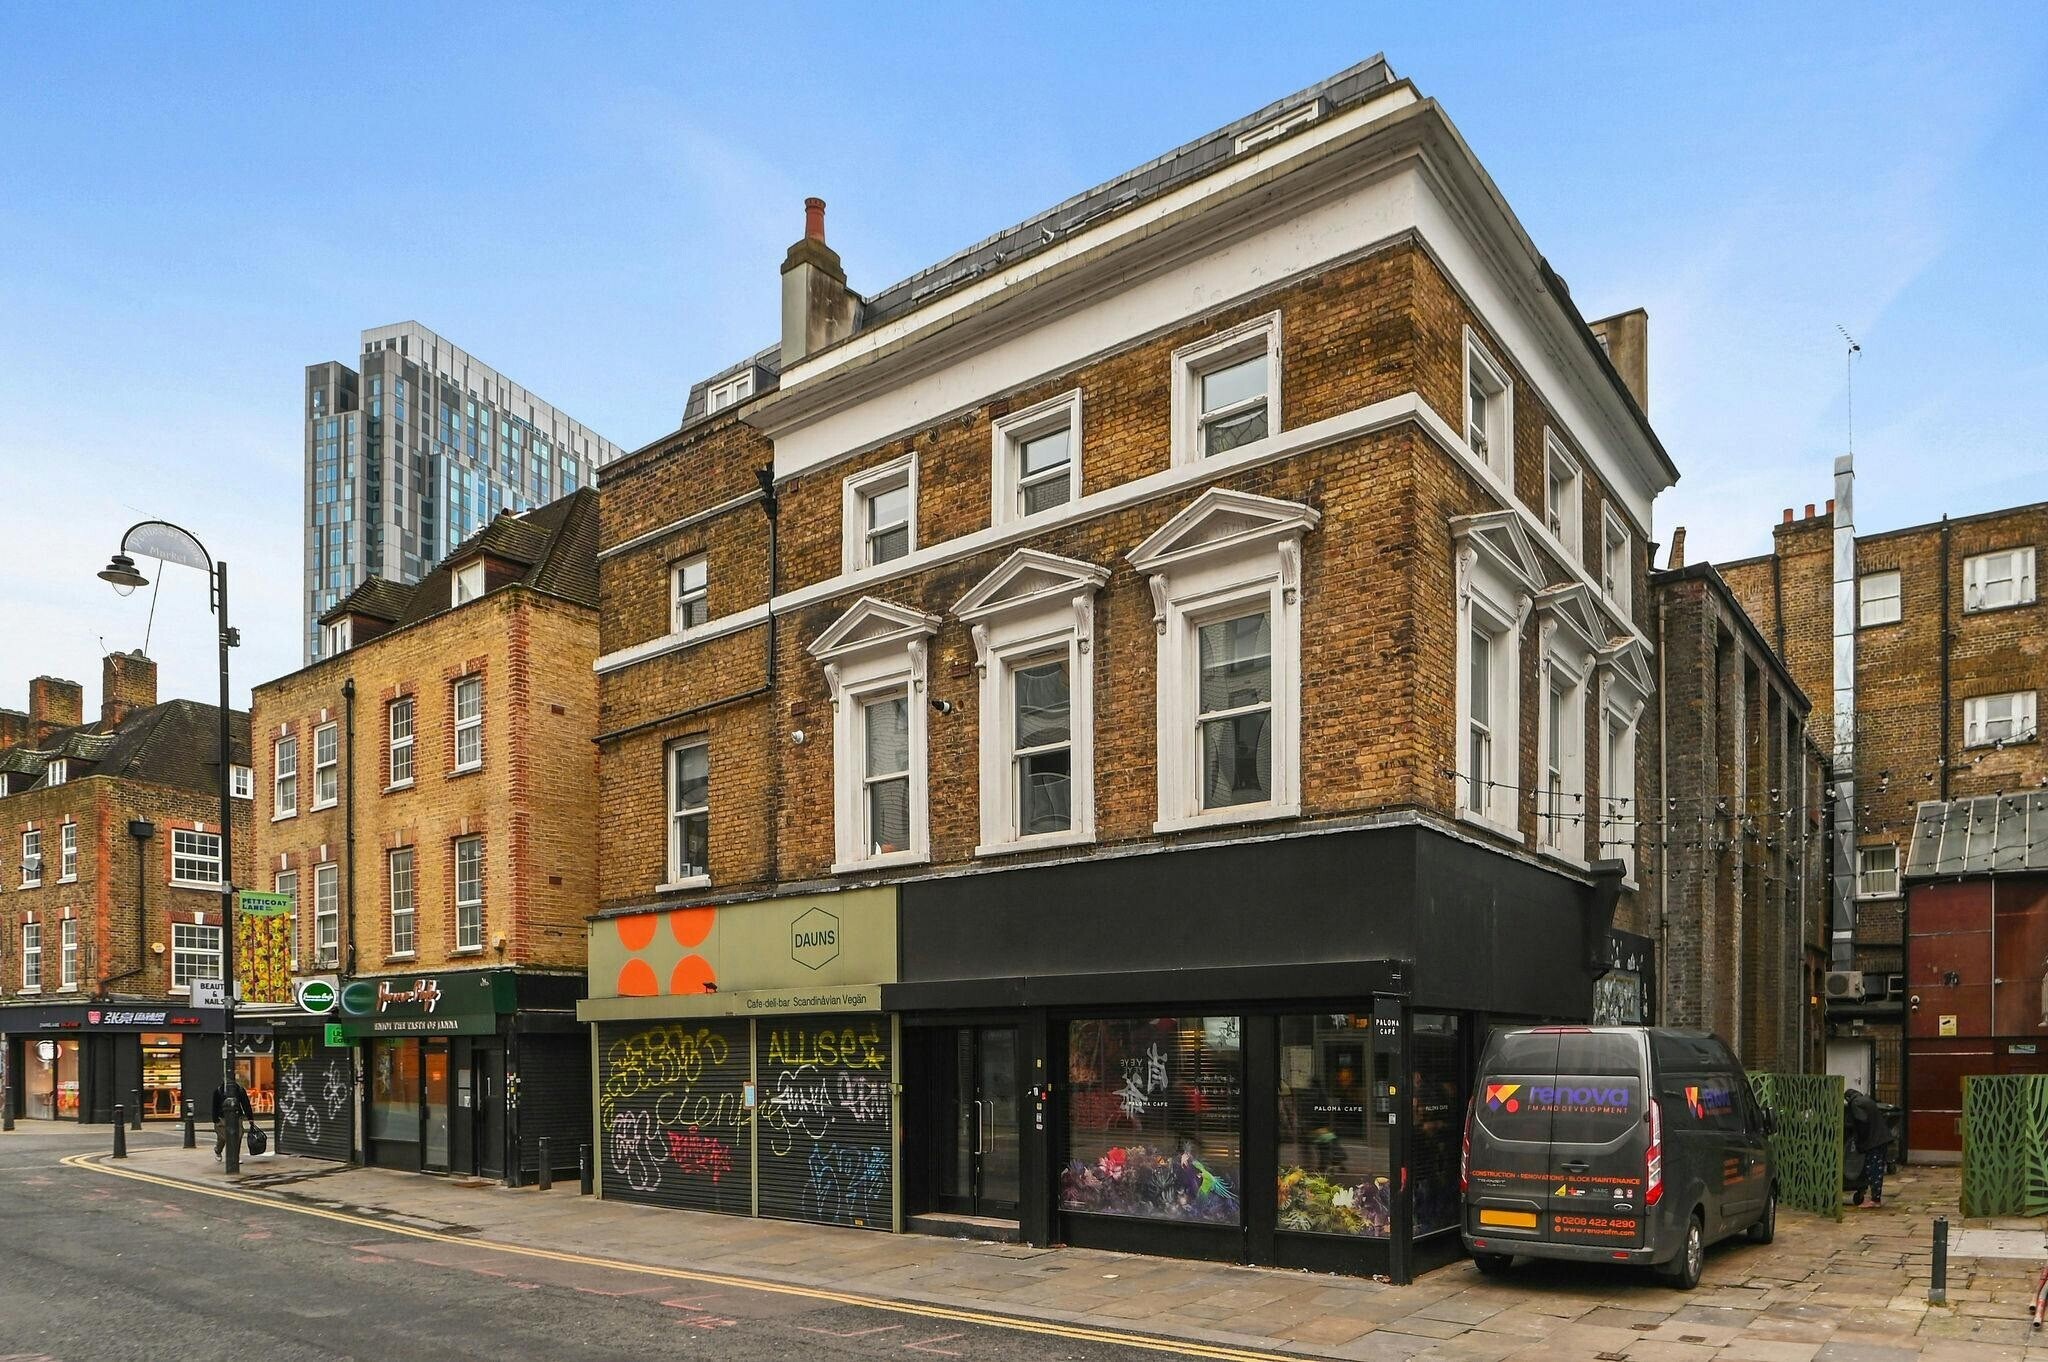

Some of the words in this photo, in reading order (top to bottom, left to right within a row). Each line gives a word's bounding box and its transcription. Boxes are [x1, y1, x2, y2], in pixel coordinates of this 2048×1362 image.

[242, 898, 287, 906] PETTICOAT
[795, 930, 835, 948] DAUNS
[1375, 1018, 1400, 1027] PALOMA
[1379, 1027, 1396, 1036] CAFÉ
[1530, 1086, 1628, 1107] renova
[1561, 1105, 1628, 1114] DEVELOPMENT
[1471, 1170, 1516, 1178] CONSTRUCTION
[1520, 1173, 1565, 1181] RENOVATIONS
[1568, 1175, 1592, 1183] BLOCK
[1592, 1176, 1641, 1185] MAINTENANCE
[1562, 1216, 1587, 1226] 0208
[1588, 1218, 1608, 1227] 422
[1609, 1219, 1636, 1229] 4290
[1563, 1226, 1635, 1237] www.renovafm.com
